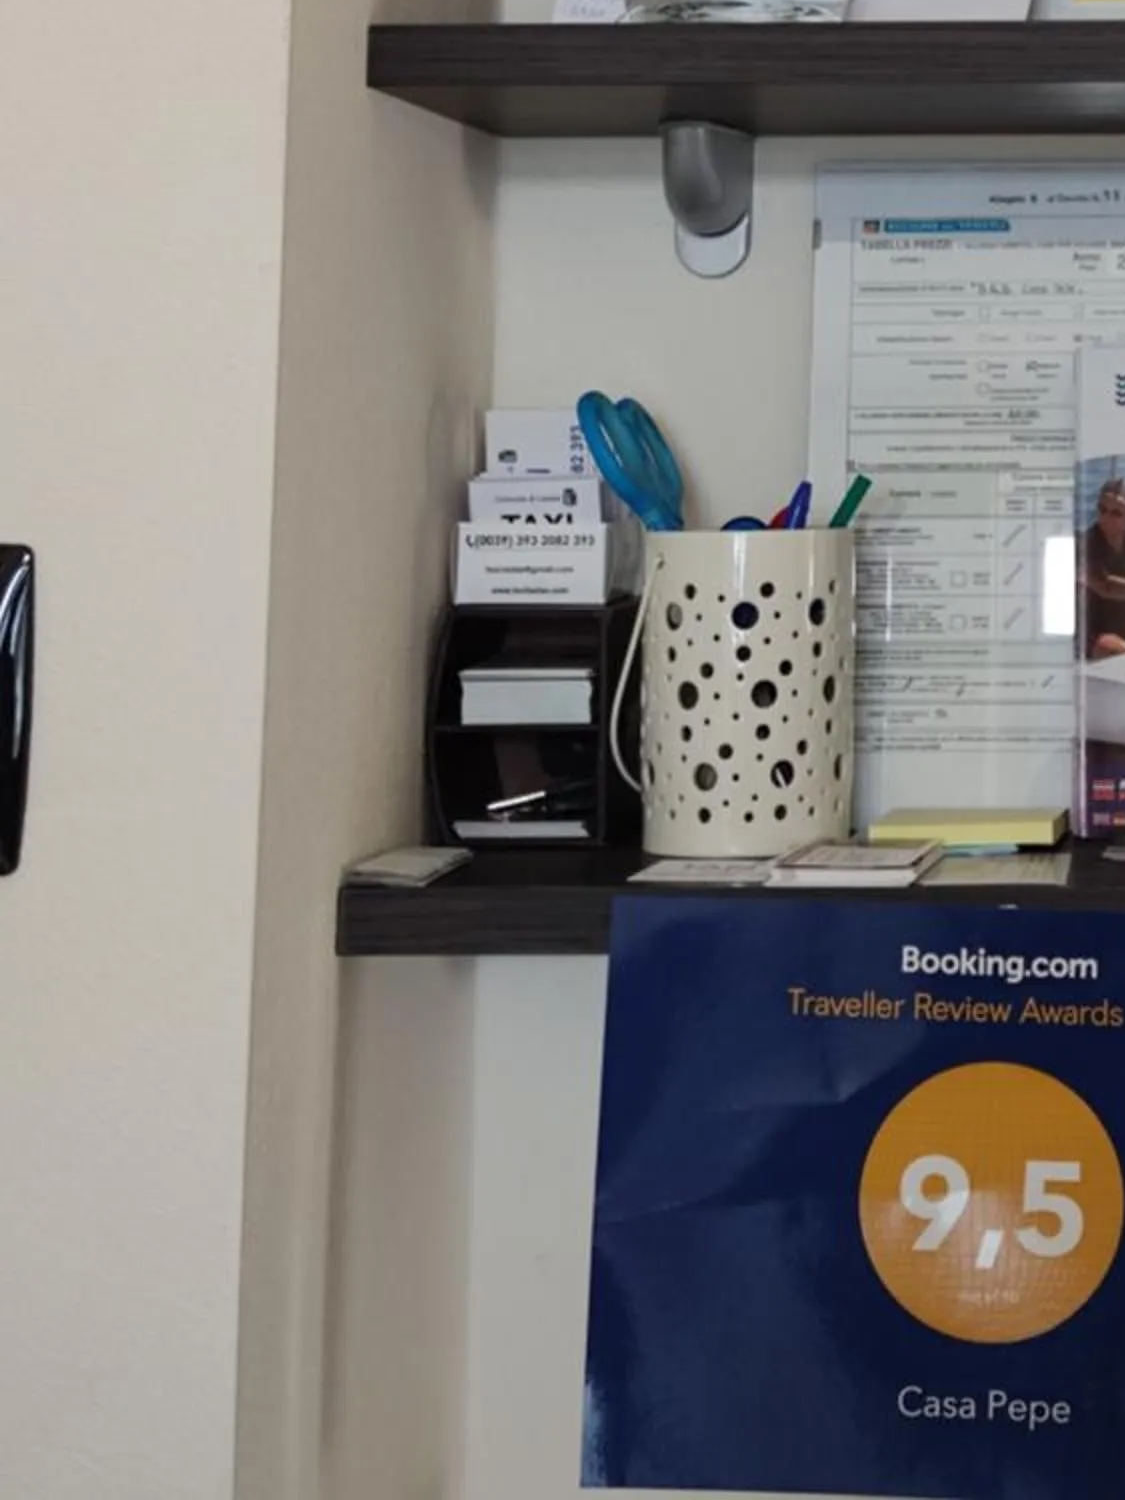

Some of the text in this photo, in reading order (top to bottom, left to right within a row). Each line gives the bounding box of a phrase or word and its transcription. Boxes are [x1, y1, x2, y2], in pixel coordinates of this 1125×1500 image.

[860, 239, 911, 251] TABELLA
[901, 944, 1099, 984] Booking.com
[788, 987, 904, 1019] Traveller
[913, 992, 1011, 1023] Review
[1019, 996, 1123, 1028] Awards
[898, 1153, 1085, 1270] 9,5
[897, 1384, 1072, 1432] Casa Pepe
